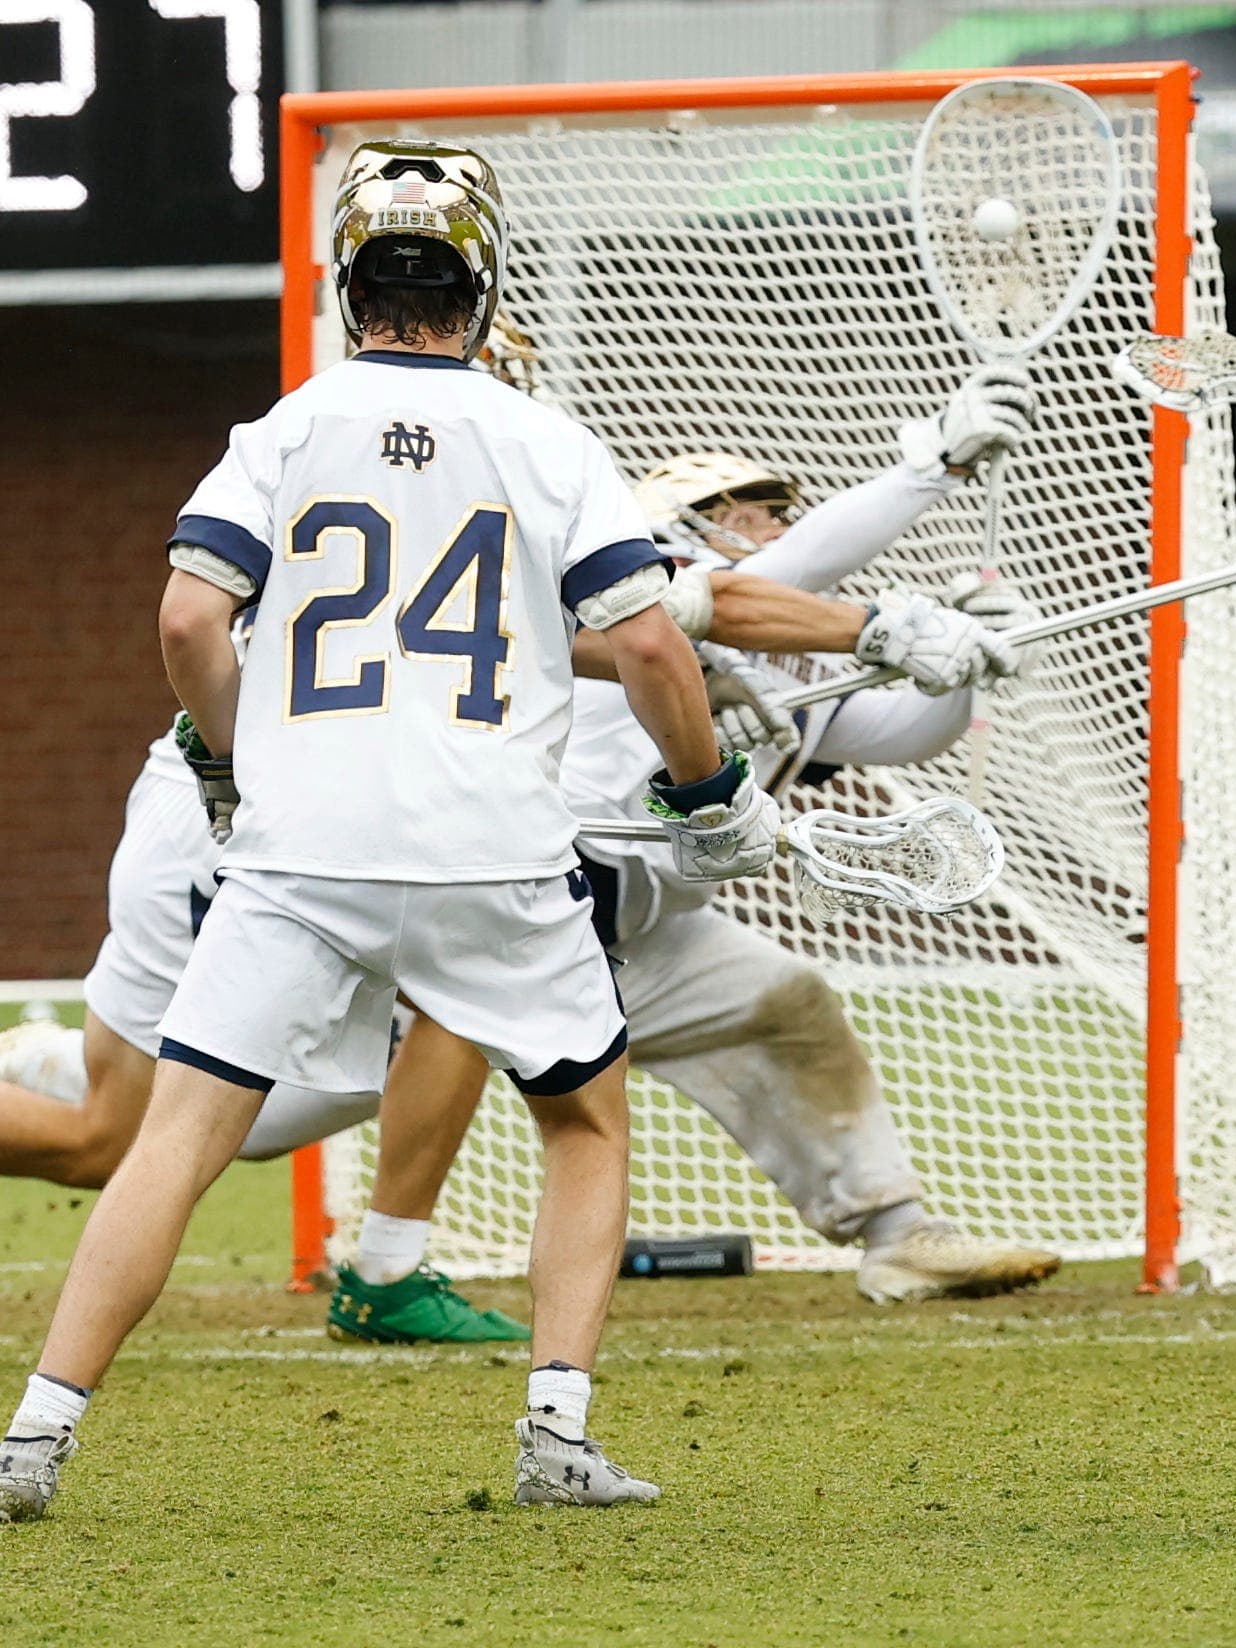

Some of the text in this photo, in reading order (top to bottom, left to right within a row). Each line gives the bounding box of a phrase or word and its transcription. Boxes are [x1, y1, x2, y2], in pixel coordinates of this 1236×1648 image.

[0, 0, 264, 211] 27
[377, 209, 437, 226] IRISH
[282, 493, 514, 732] 24
